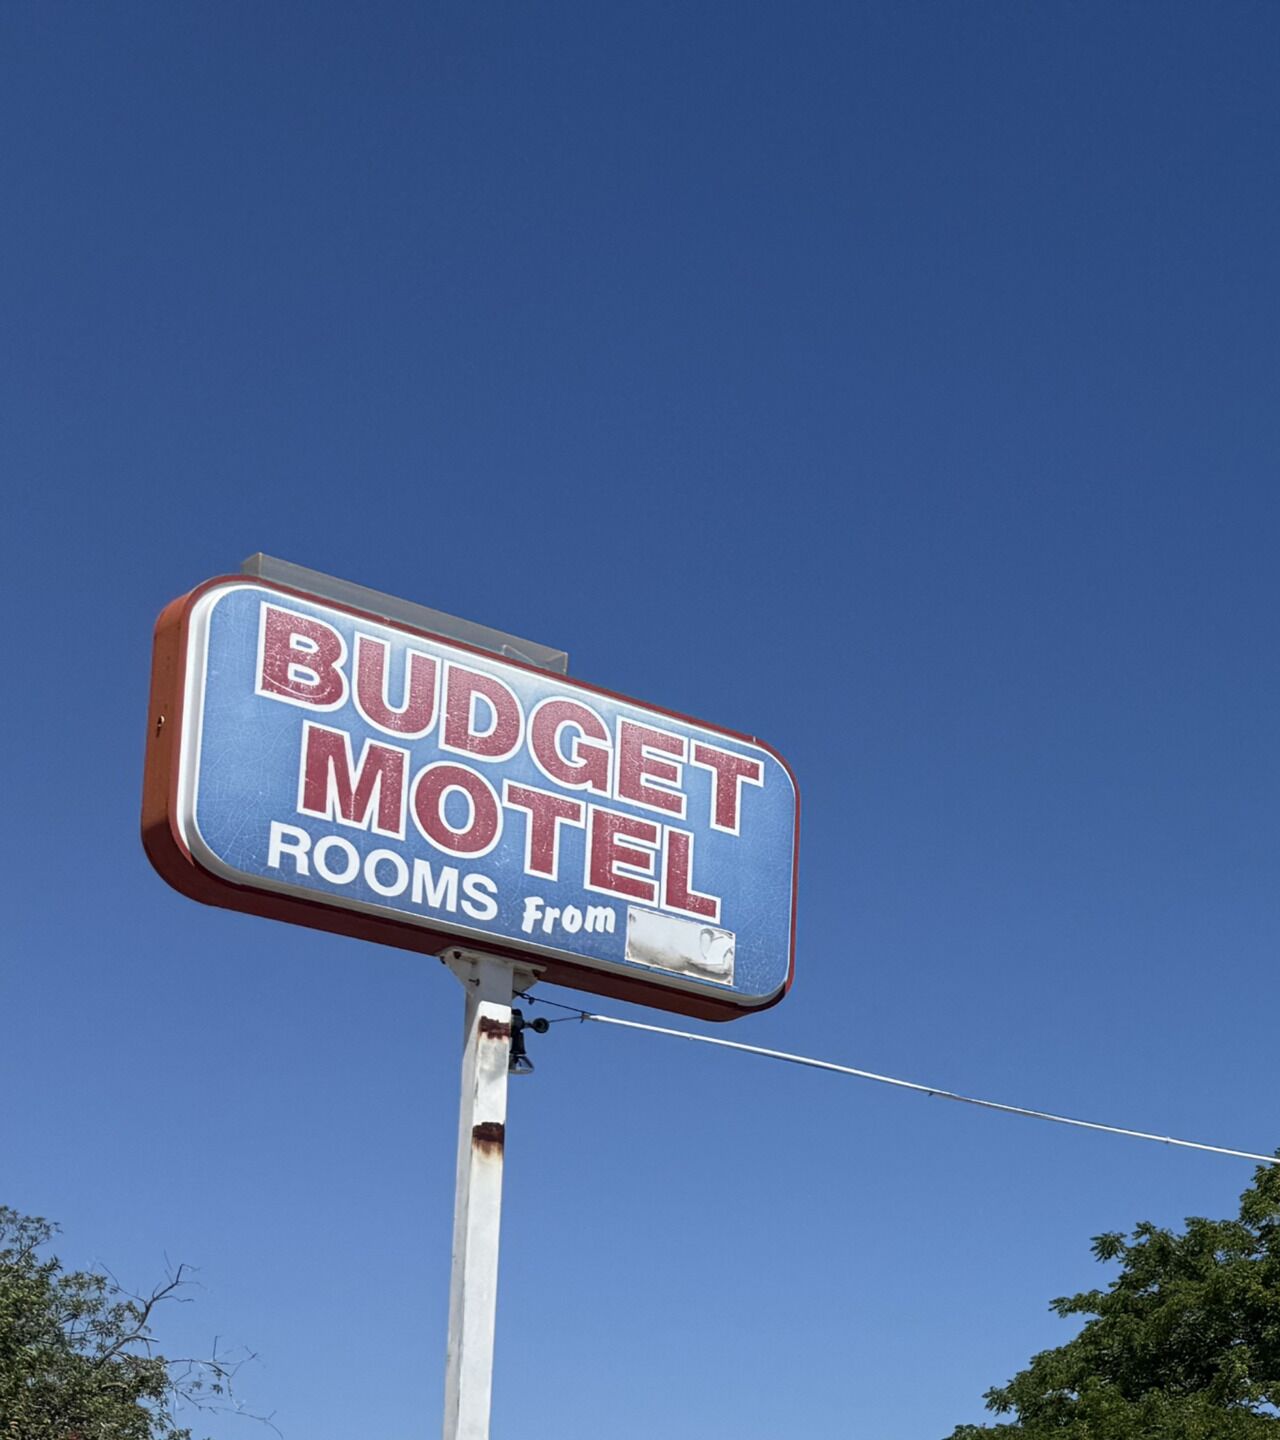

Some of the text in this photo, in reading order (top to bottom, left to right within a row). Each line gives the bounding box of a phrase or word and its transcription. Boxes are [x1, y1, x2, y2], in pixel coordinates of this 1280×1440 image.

[255, 600, 764, 837] BUDGET
[298, 718, 722, 923] MOTEL
[266, 820, 498, 920] ROOMS
